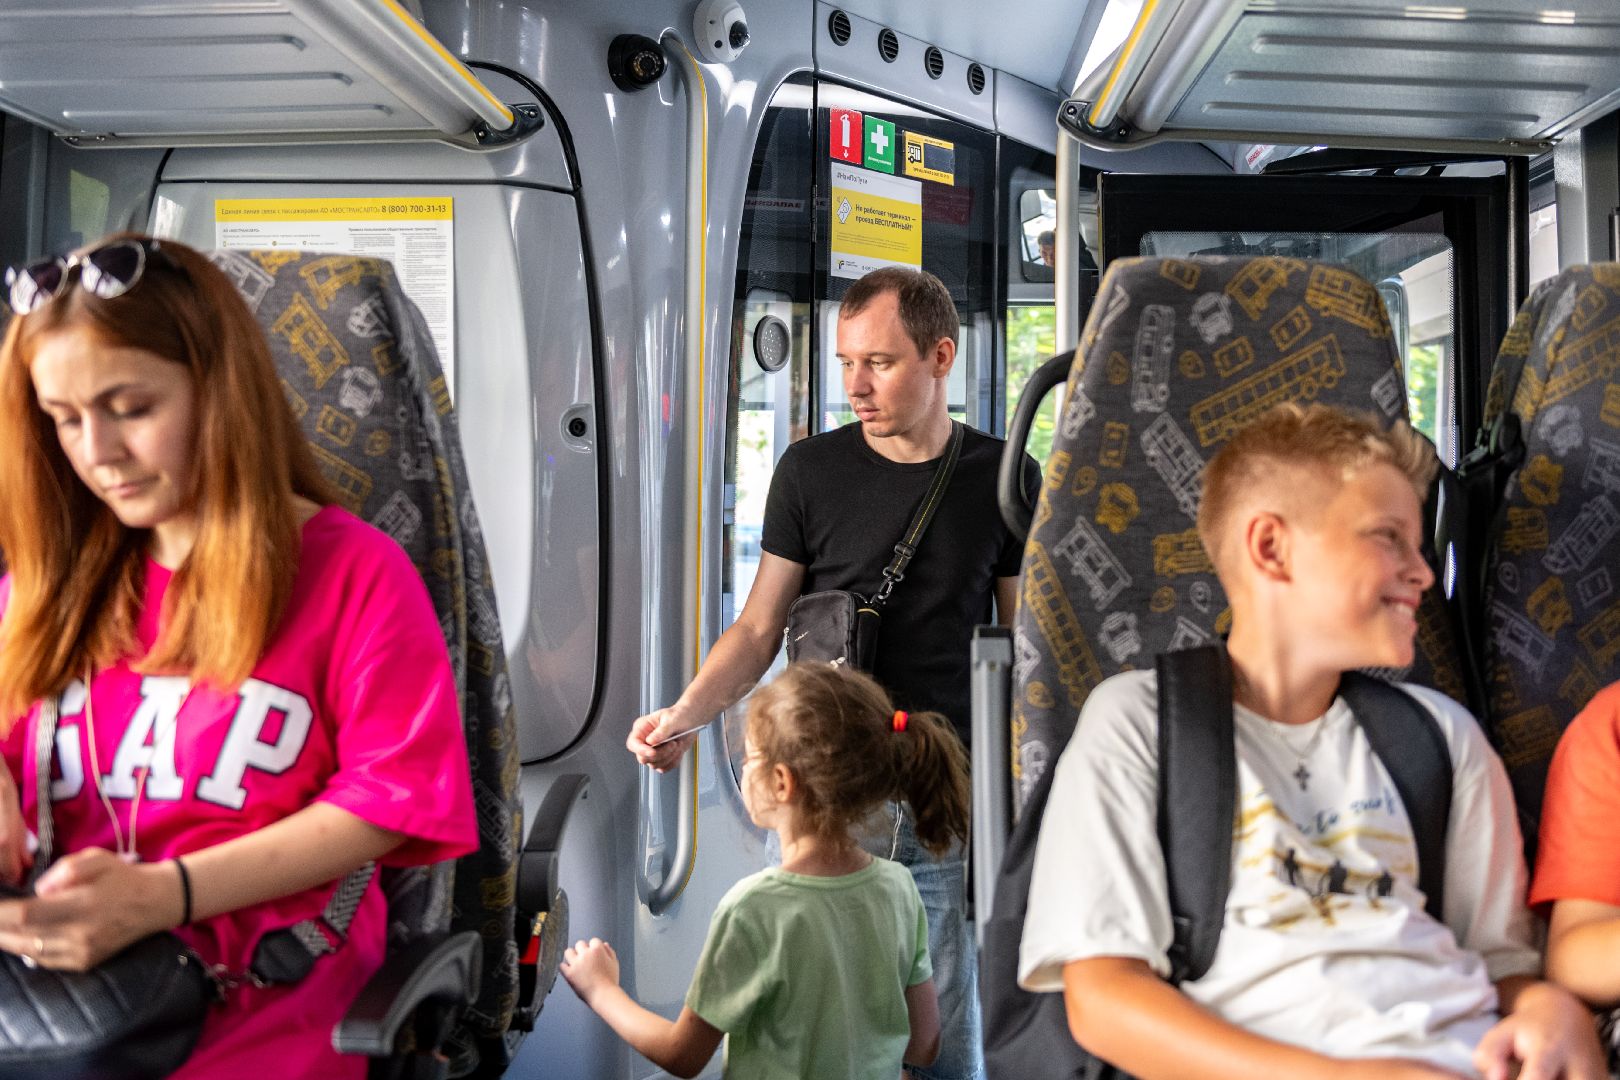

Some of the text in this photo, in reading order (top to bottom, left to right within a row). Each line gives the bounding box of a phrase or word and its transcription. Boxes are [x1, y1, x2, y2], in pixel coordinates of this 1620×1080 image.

[381, 205, 387, 213] 8
[388, 204, 408, 214] (800)
[410, 204, 447, 213] 700-31-13
[855, 203, 863, 212] Не
[863, 206, 887, 217] работает
[855, 215, 874, 225] проезд
